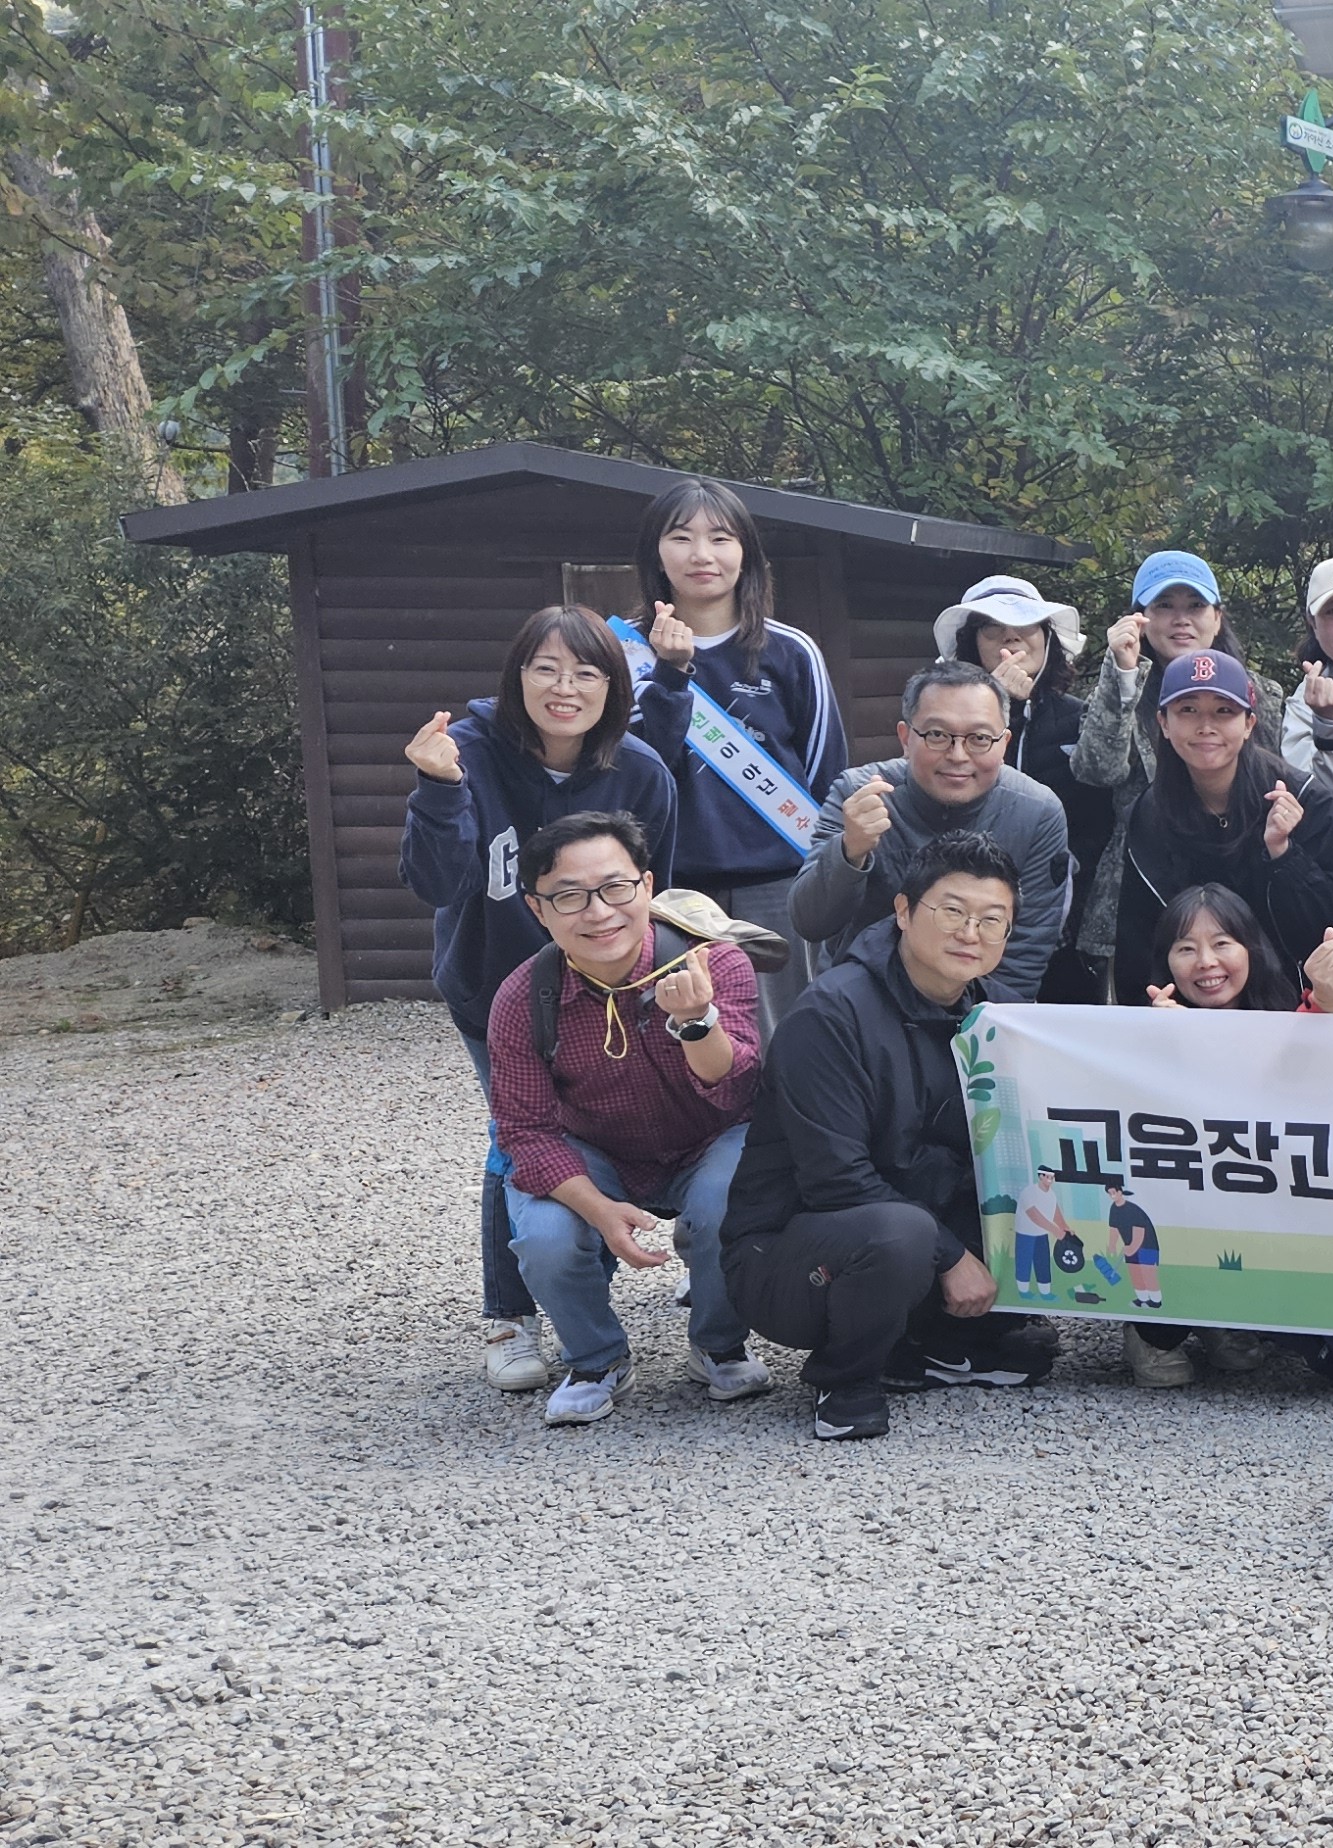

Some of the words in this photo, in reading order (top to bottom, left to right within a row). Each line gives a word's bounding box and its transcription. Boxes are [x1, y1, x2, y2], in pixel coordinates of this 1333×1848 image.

[1190, 656, 1216, 682] B
[690, 711, 740, 759] 선택이
[741, 763, 778, 796] 아닌
[777, 798, 811, 830] 필수
